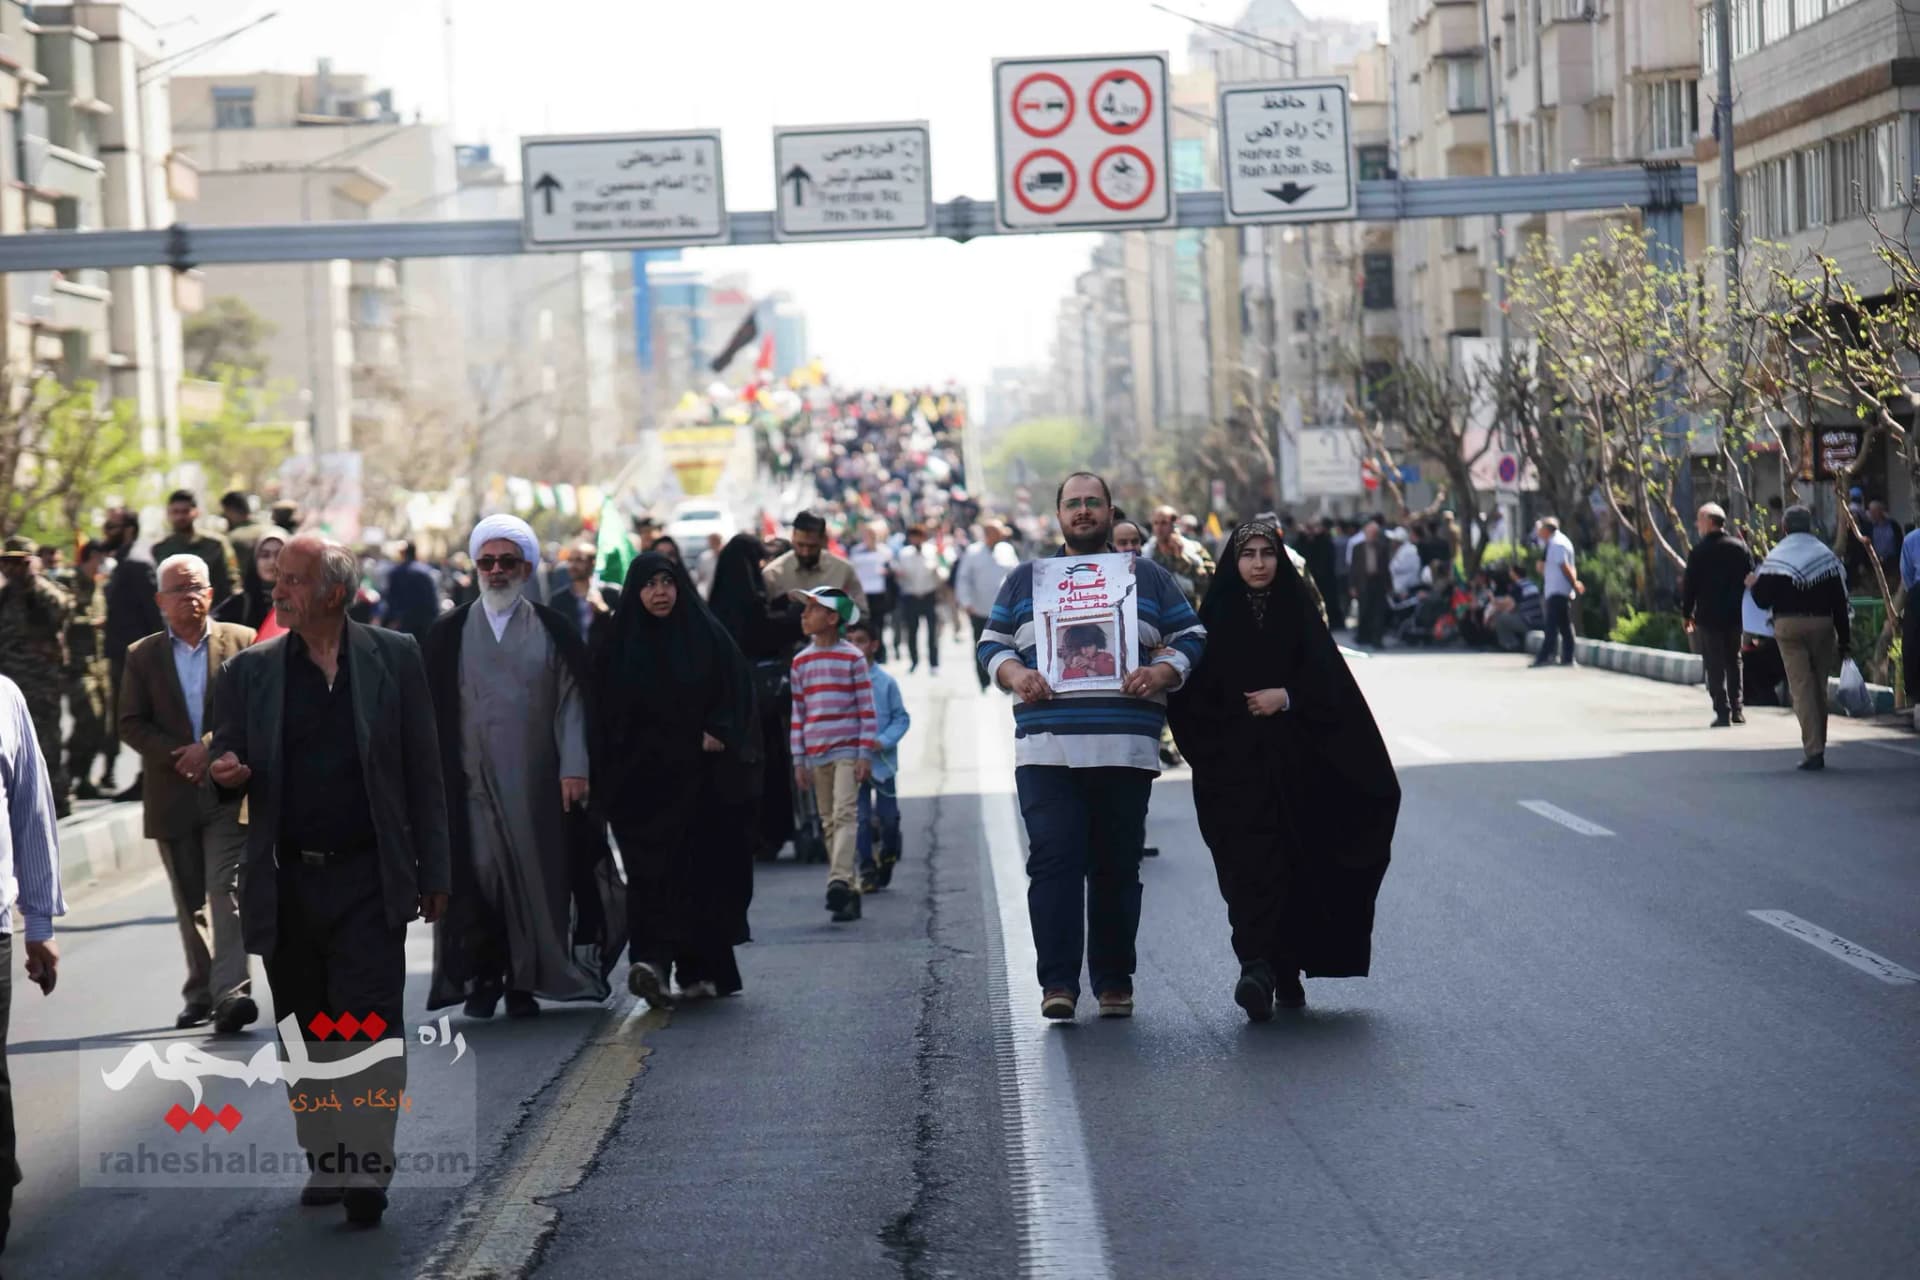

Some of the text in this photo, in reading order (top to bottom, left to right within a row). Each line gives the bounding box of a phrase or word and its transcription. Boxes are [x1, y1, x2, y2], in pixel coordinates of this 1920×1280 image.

[1262, 94, 1305, 110] حافظ
[1245, 120, 1308, 143] راه آهن
[823, 138, 895, 161] فردوسی
